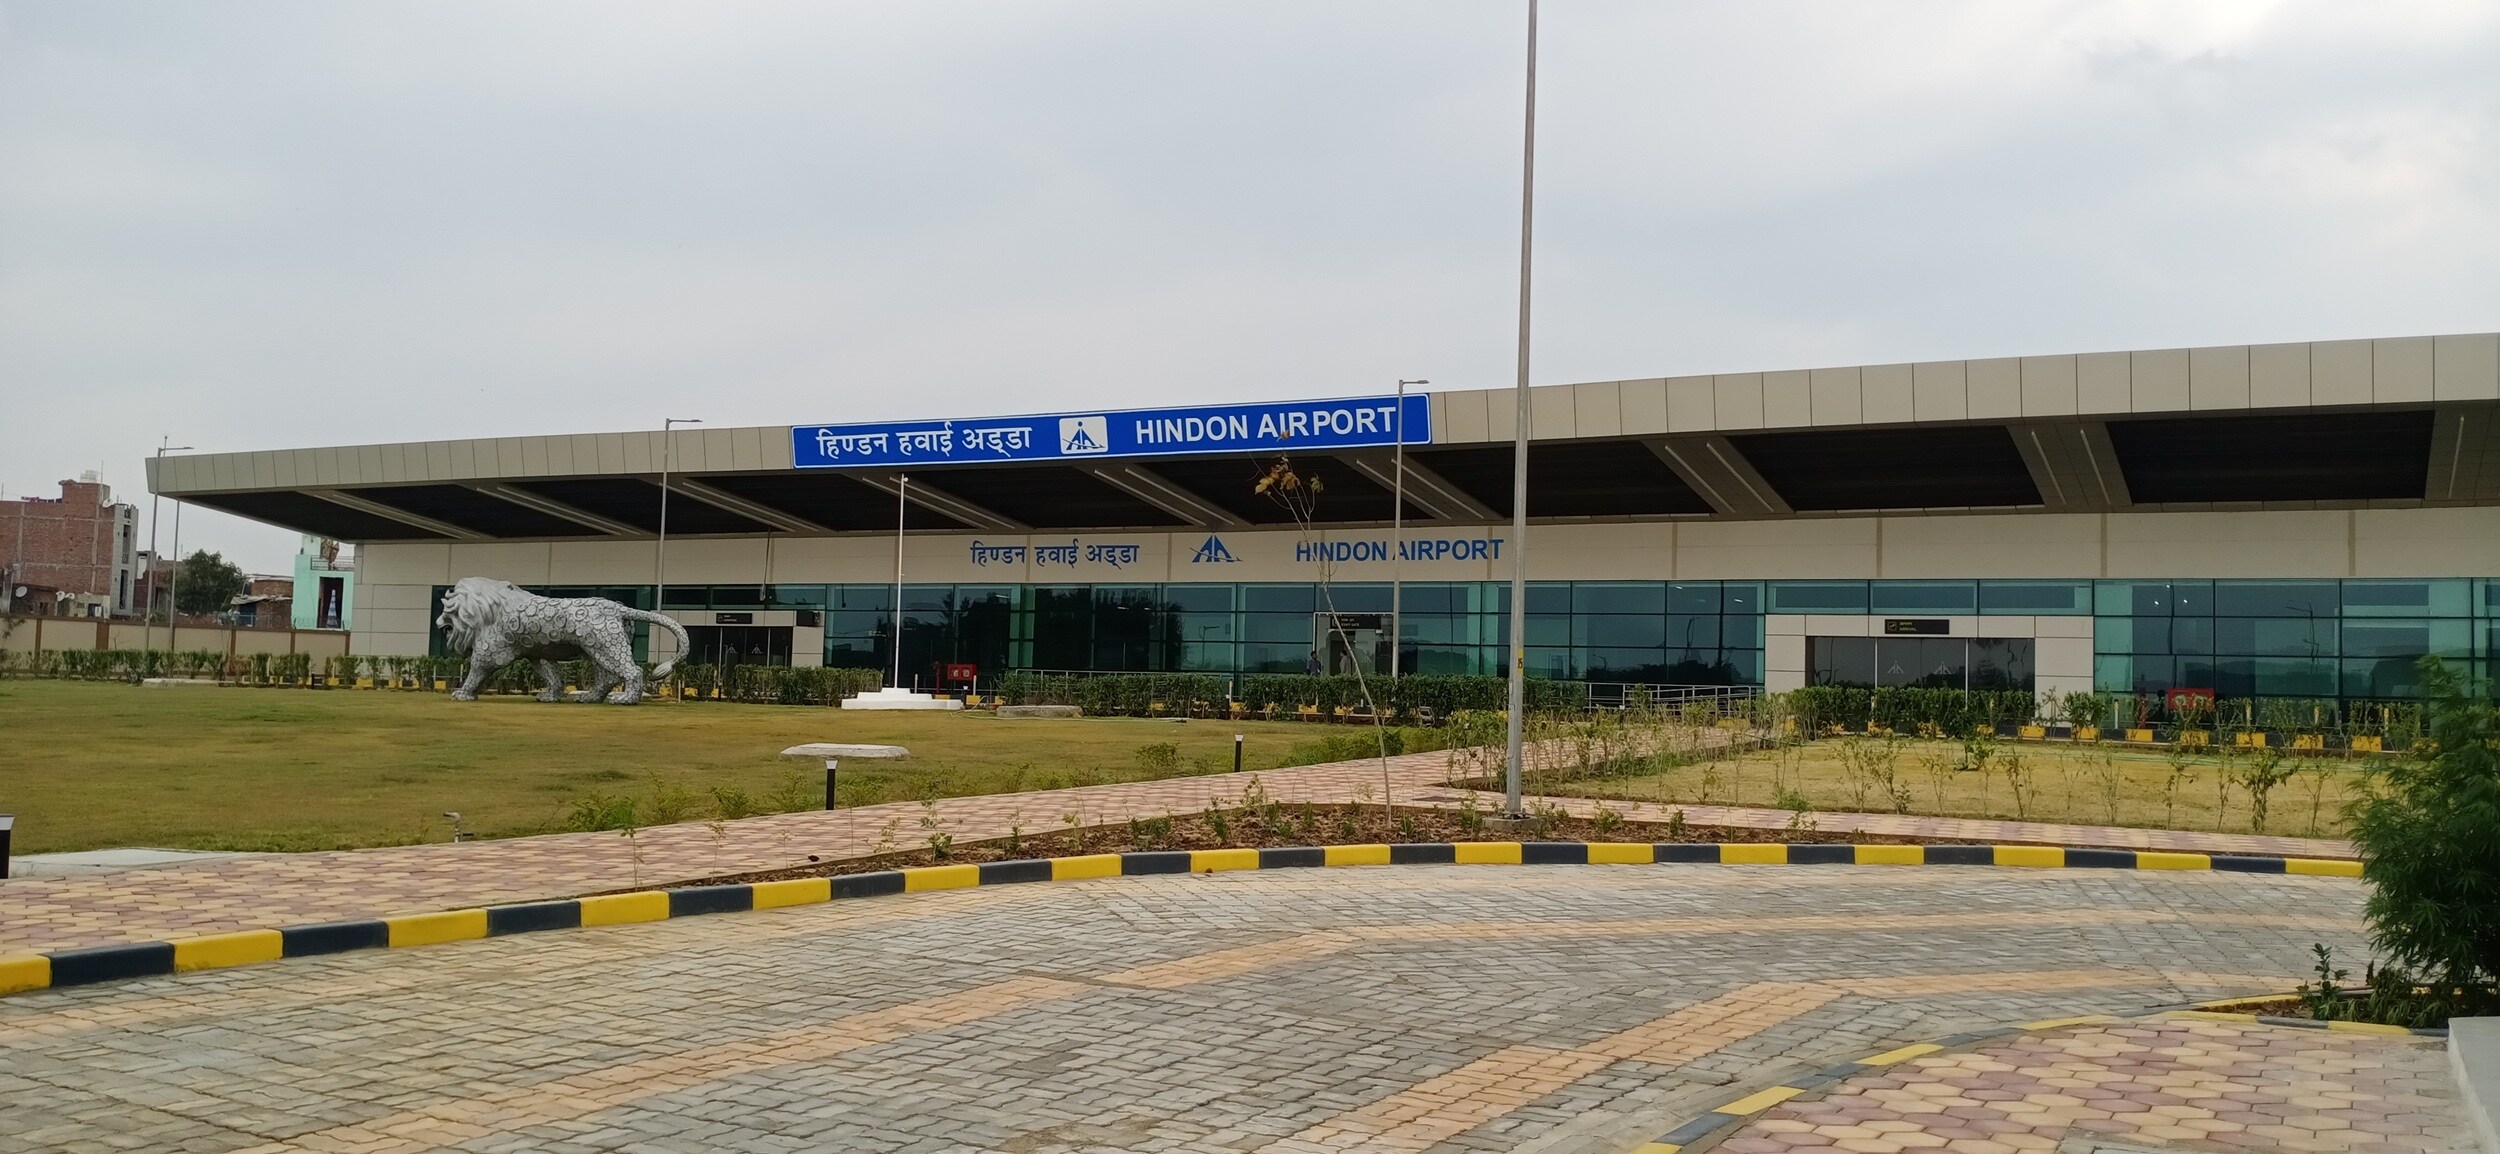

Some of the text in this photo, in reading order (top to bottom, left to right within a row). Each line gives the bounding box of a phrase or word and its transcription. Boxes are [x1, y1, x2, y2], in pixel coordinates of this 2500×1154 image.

[815, 428, 889, 459] हिण्डन
[896, 421, 954, 457] हवाई
[1136, 406, 1397, 444] HINDON AIRPORT
[970, 540, 1027, 567] हिण्डन
[1034, 538, 1079, 569] हवाई
[1296, 539, 1504, 561] HINDON AIRPORT
